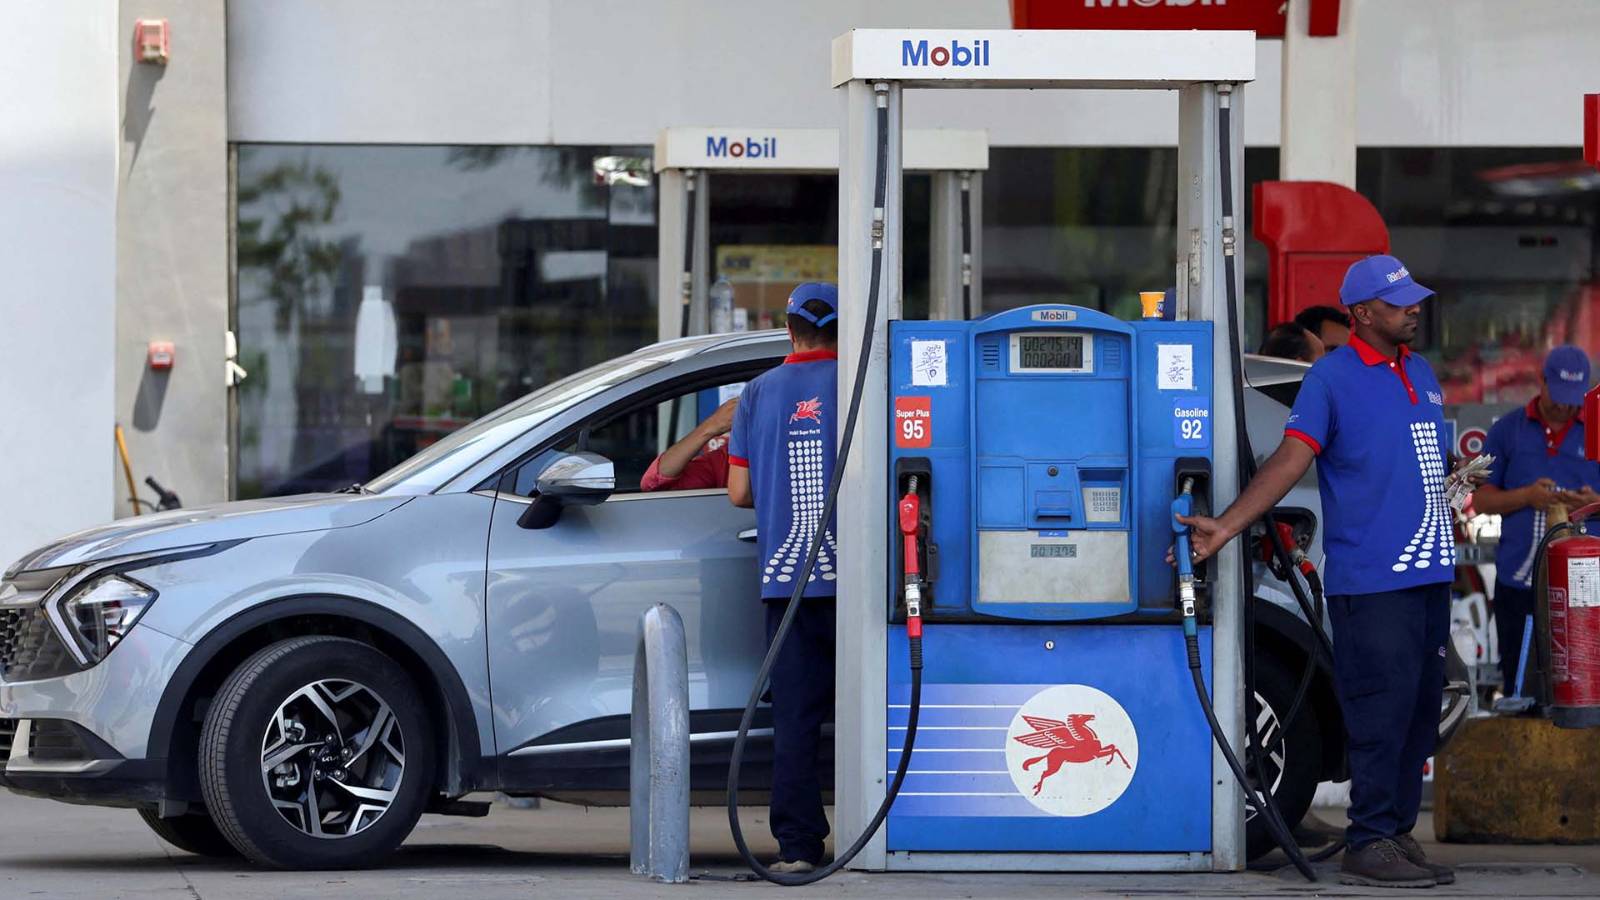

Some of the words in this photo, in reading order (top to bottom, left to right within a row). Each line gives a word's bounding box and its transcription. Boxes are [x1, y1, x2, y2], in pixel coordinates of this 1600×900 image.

[902, 40, 989, 66] Mobil
[706, 136, 776, 158] Mobil
[1040, 311, 1068, 321] Mobil
[896, 409, 915, 419] Super
[916, 409, 930, 418] Plus
[1174, 407, 1209, 418] Gasoline
[903, 419, 924, 440] 95
[1181, 419, 1202, 440] 92
